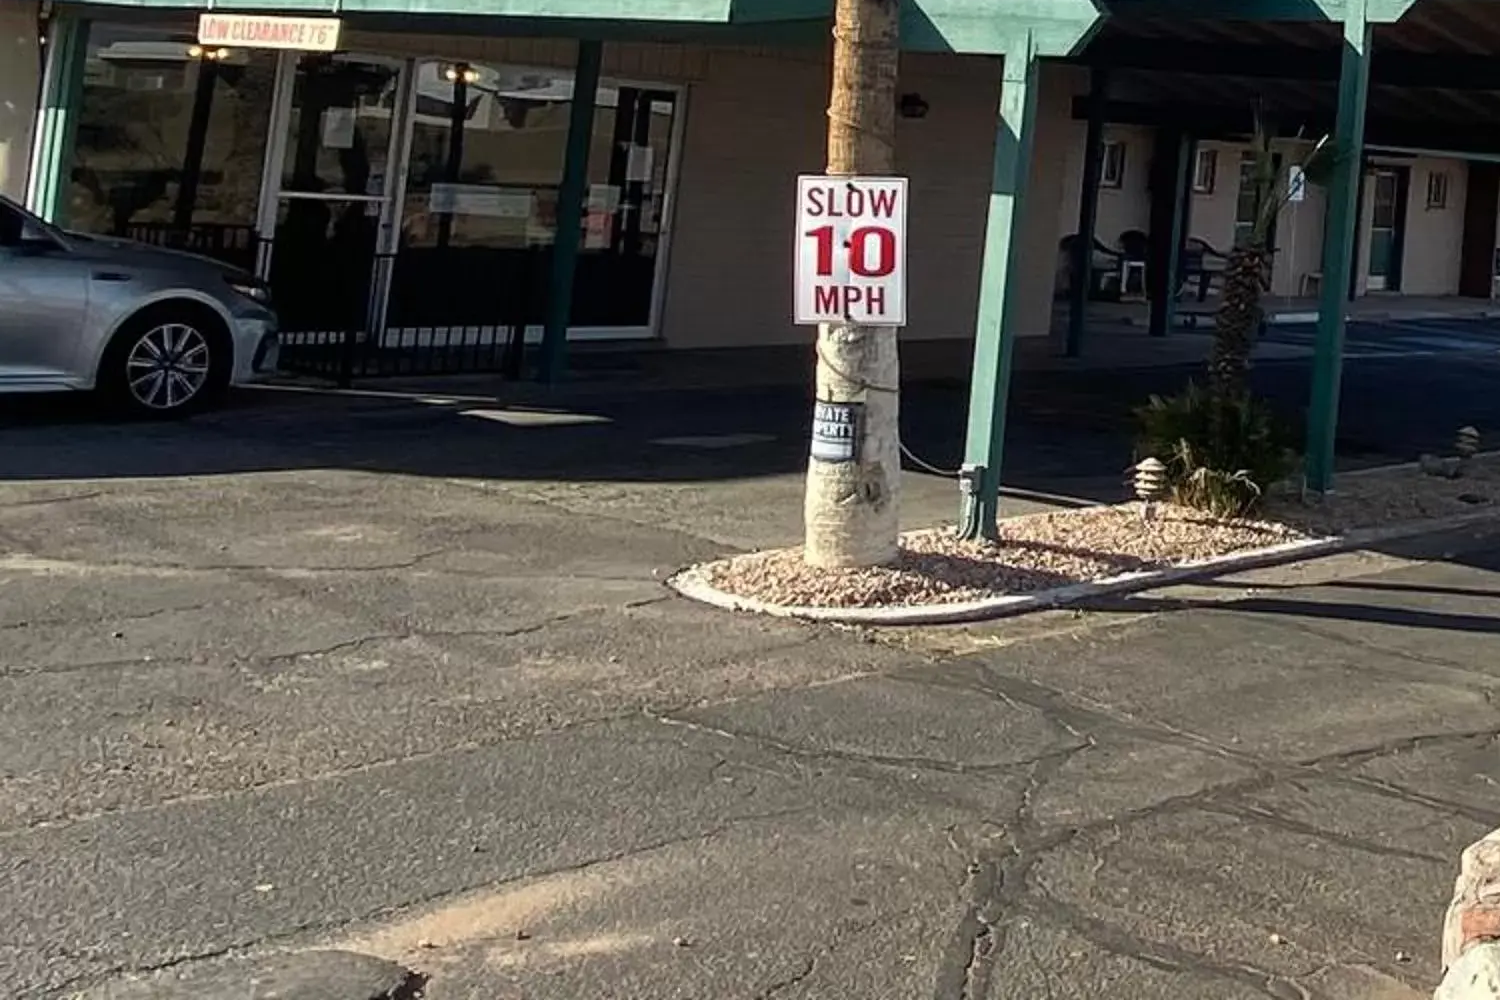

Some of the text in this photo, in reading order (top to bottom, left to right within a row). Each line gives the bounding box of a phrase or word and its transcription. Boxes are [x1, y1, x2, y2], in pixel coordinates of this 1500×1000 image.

[203, 18, 230, 40] LOW
[231, 19, 306, 44] CLEARANCE
[806, 187, 898, 218] SLOW
[805, 225, 896, 278] 10
[814, 285, 885, 316] MPH
